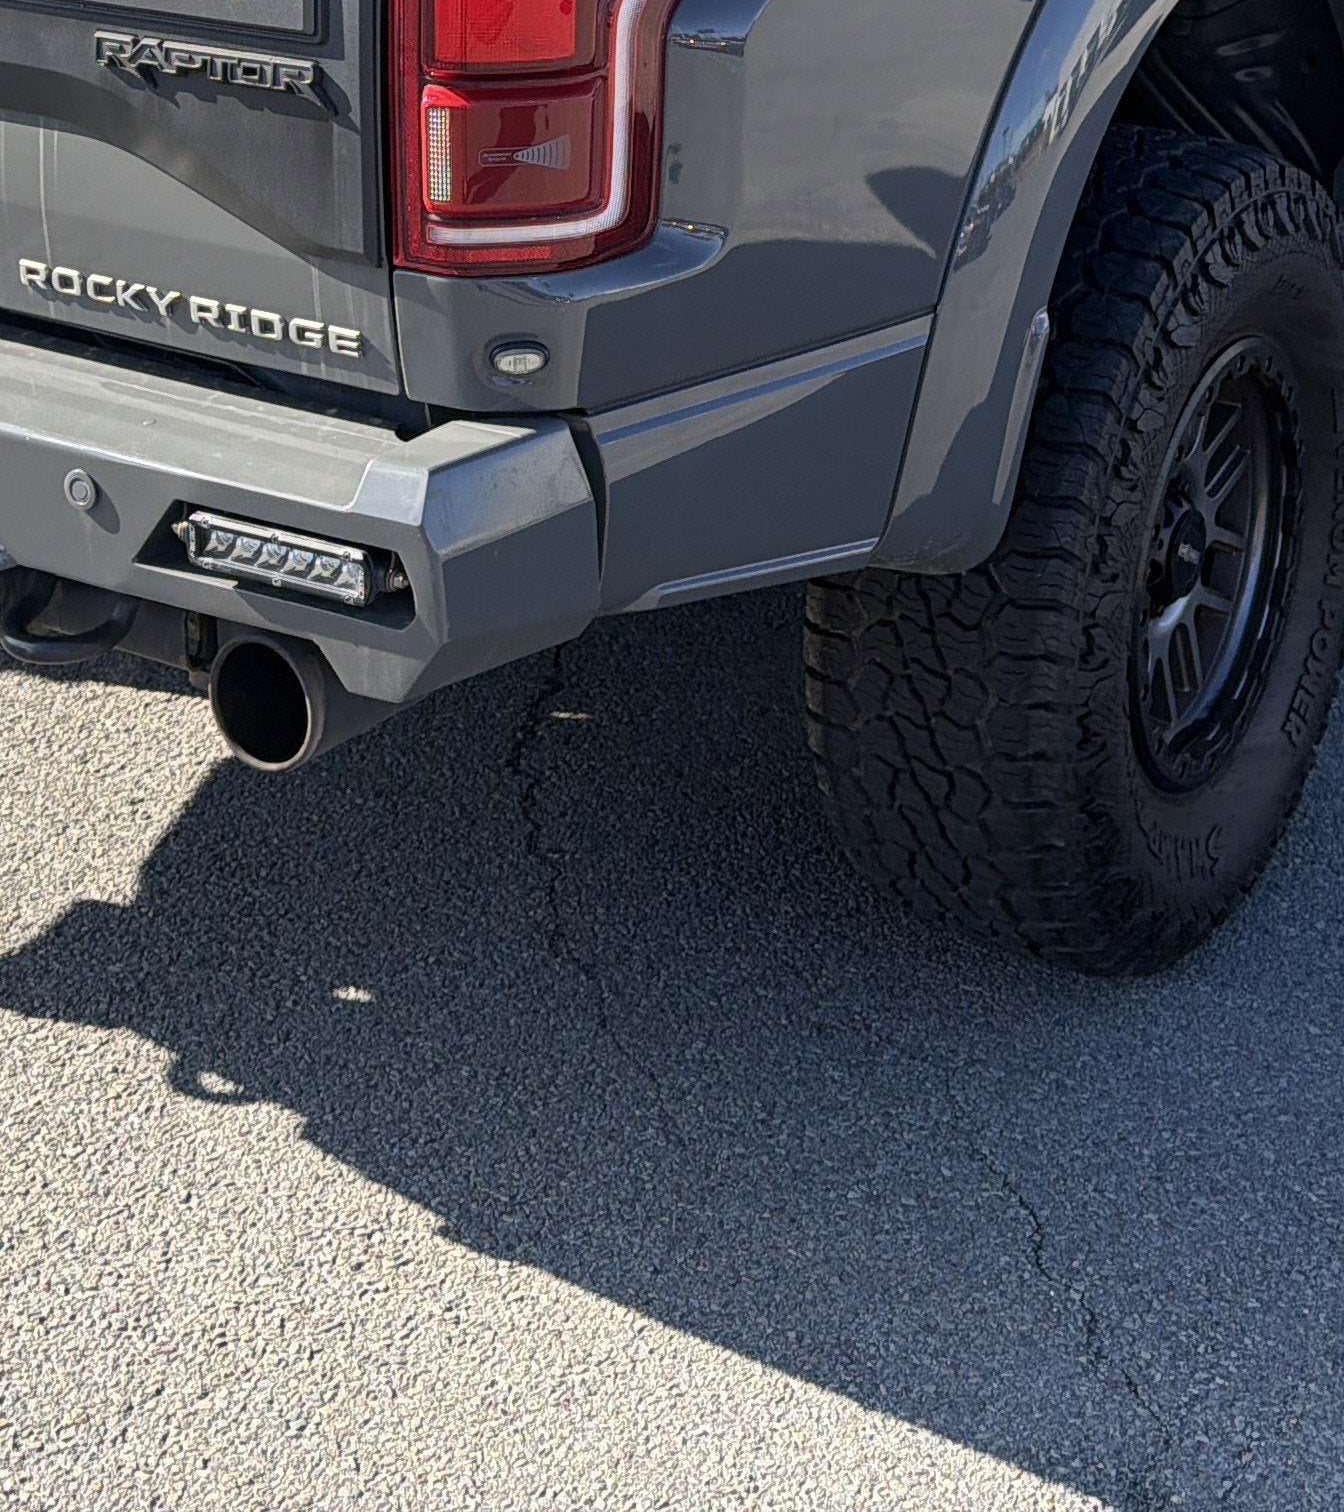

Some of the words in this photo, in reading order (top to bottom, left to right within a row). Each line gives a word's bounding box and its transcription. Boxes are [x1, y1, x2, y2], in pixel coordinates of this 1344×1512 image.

[94, 31, 324, 106] RAPTOR
[19, 259, 180, 317] ROCKY
[189, 295, 363, 359] RIDGE
[1281, 598, 1335, 749] POWER
